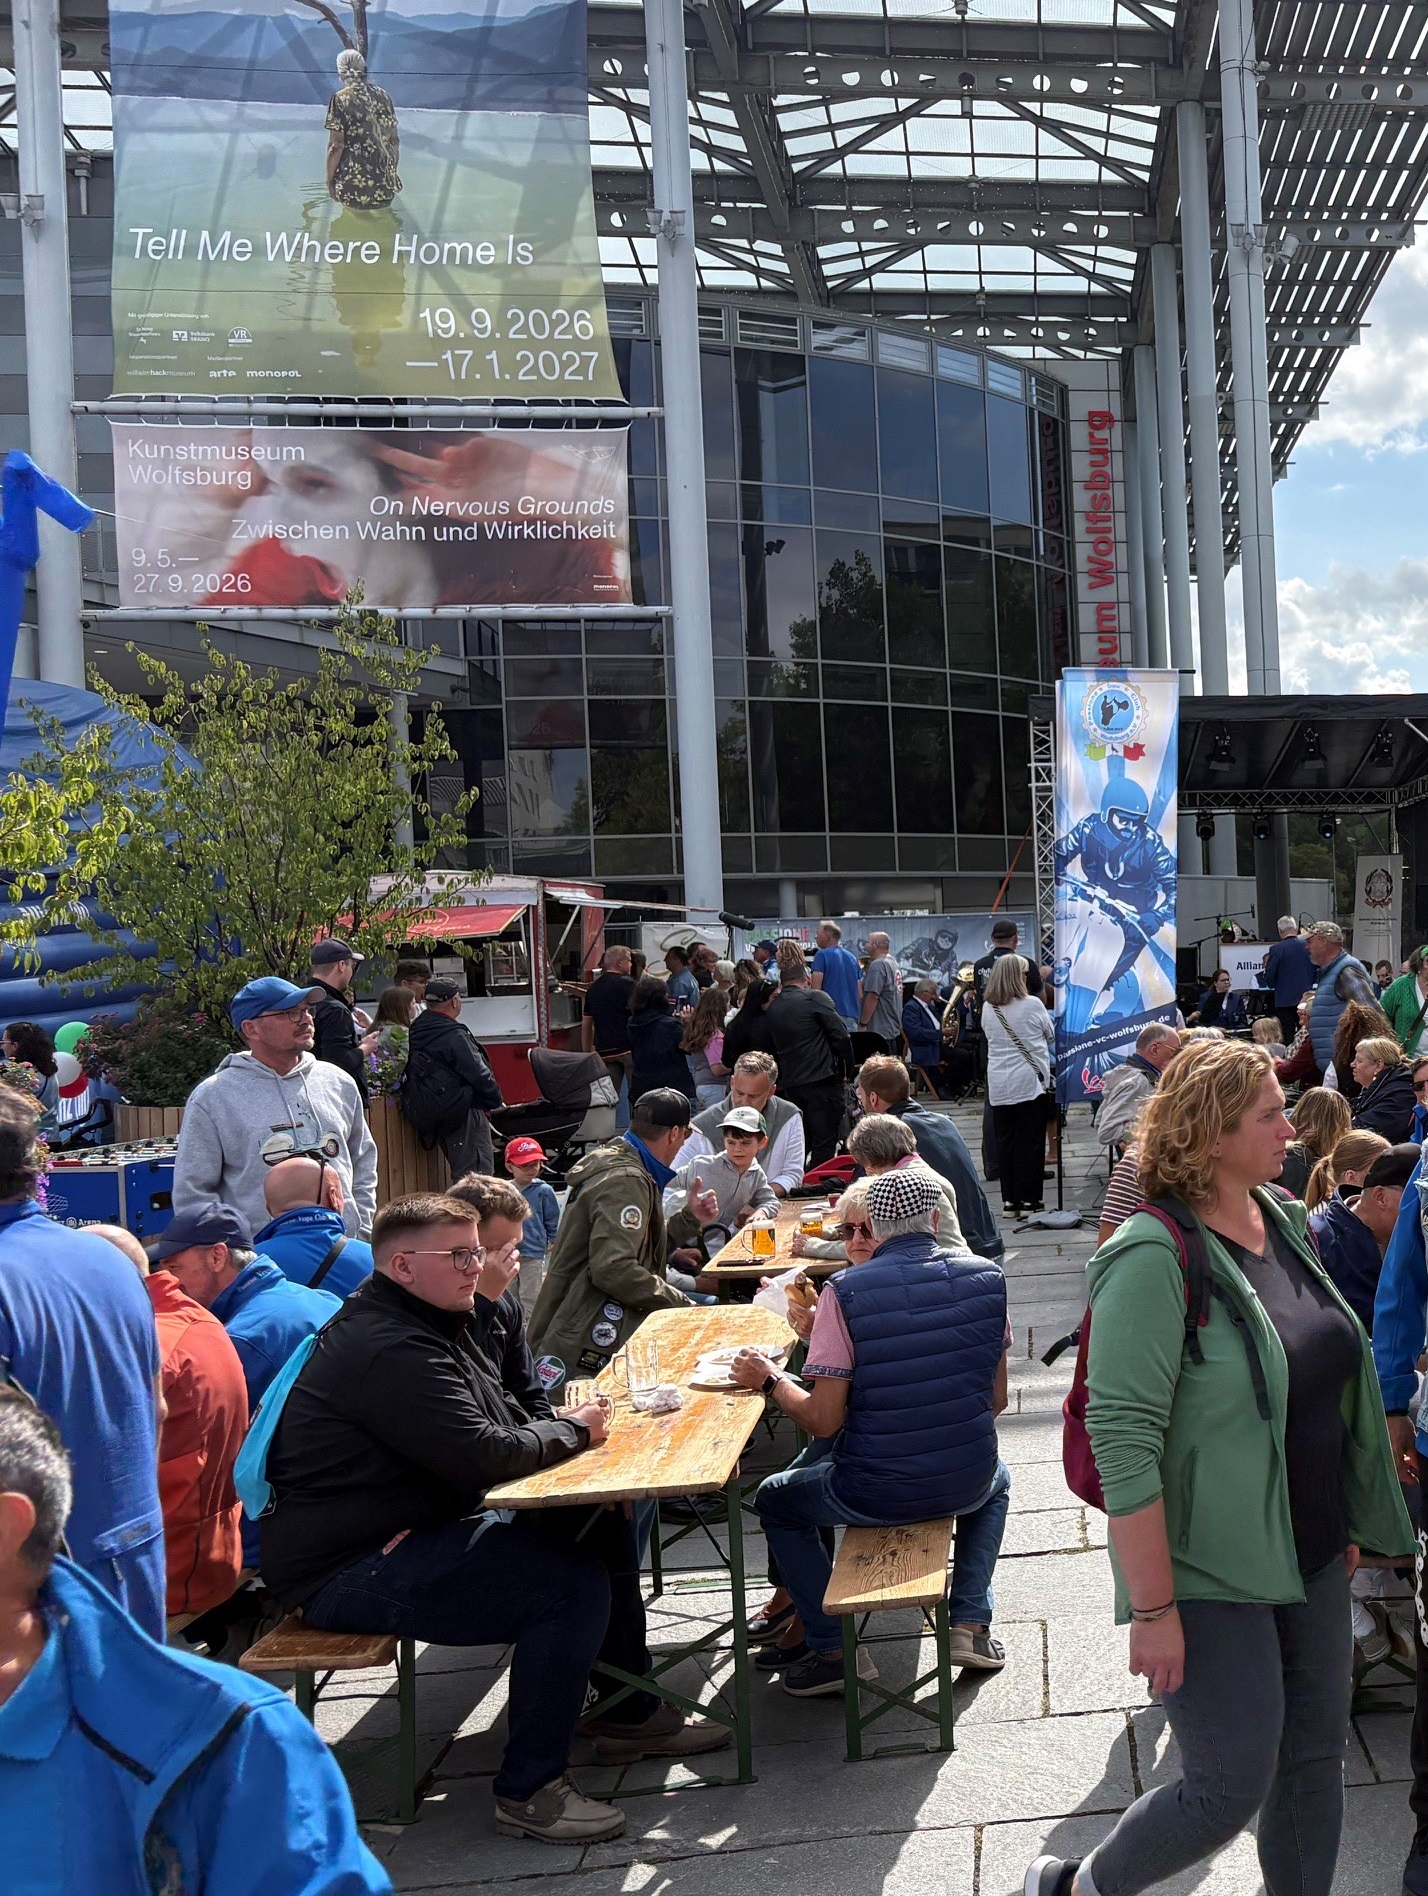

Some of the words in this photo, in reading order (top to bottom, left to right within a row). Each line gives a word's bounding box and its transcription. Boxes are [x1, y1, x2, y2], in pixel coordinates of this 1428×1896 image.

[129, 227, 187, 261] Tell
[197, 230, 253, 262] Me
[265, 231, 380, 264] Where
[392, 234, 496, 266] Home
[507, 234, 534, 266] Is
[233, 330, 247, 339] VR
[209, 370, 237, 378] arte
[128, 439, 305, 461] Kunstmuseum
[128, 464, 252, 490] Wolfsburg
[369, 496, 403, 516] On
[411, 496, 510, 516] Nervous
[517, 496, 615, 516] Grounds
[1084, 410, 1115, 590] Wolfsburg
[232, 519, 349, 541] Zwischen
[356, 521, 426, 541] Wahn
[433, 521, 477, 541] und
[484, 520, 616, 542] Wirklichkeit
[134, 573, 252, 593] 27.9.2026
[1236, 961, 1265, 971] Allian
[1057, 1014, 1171, 1062] passione-vc-wolfsburde
